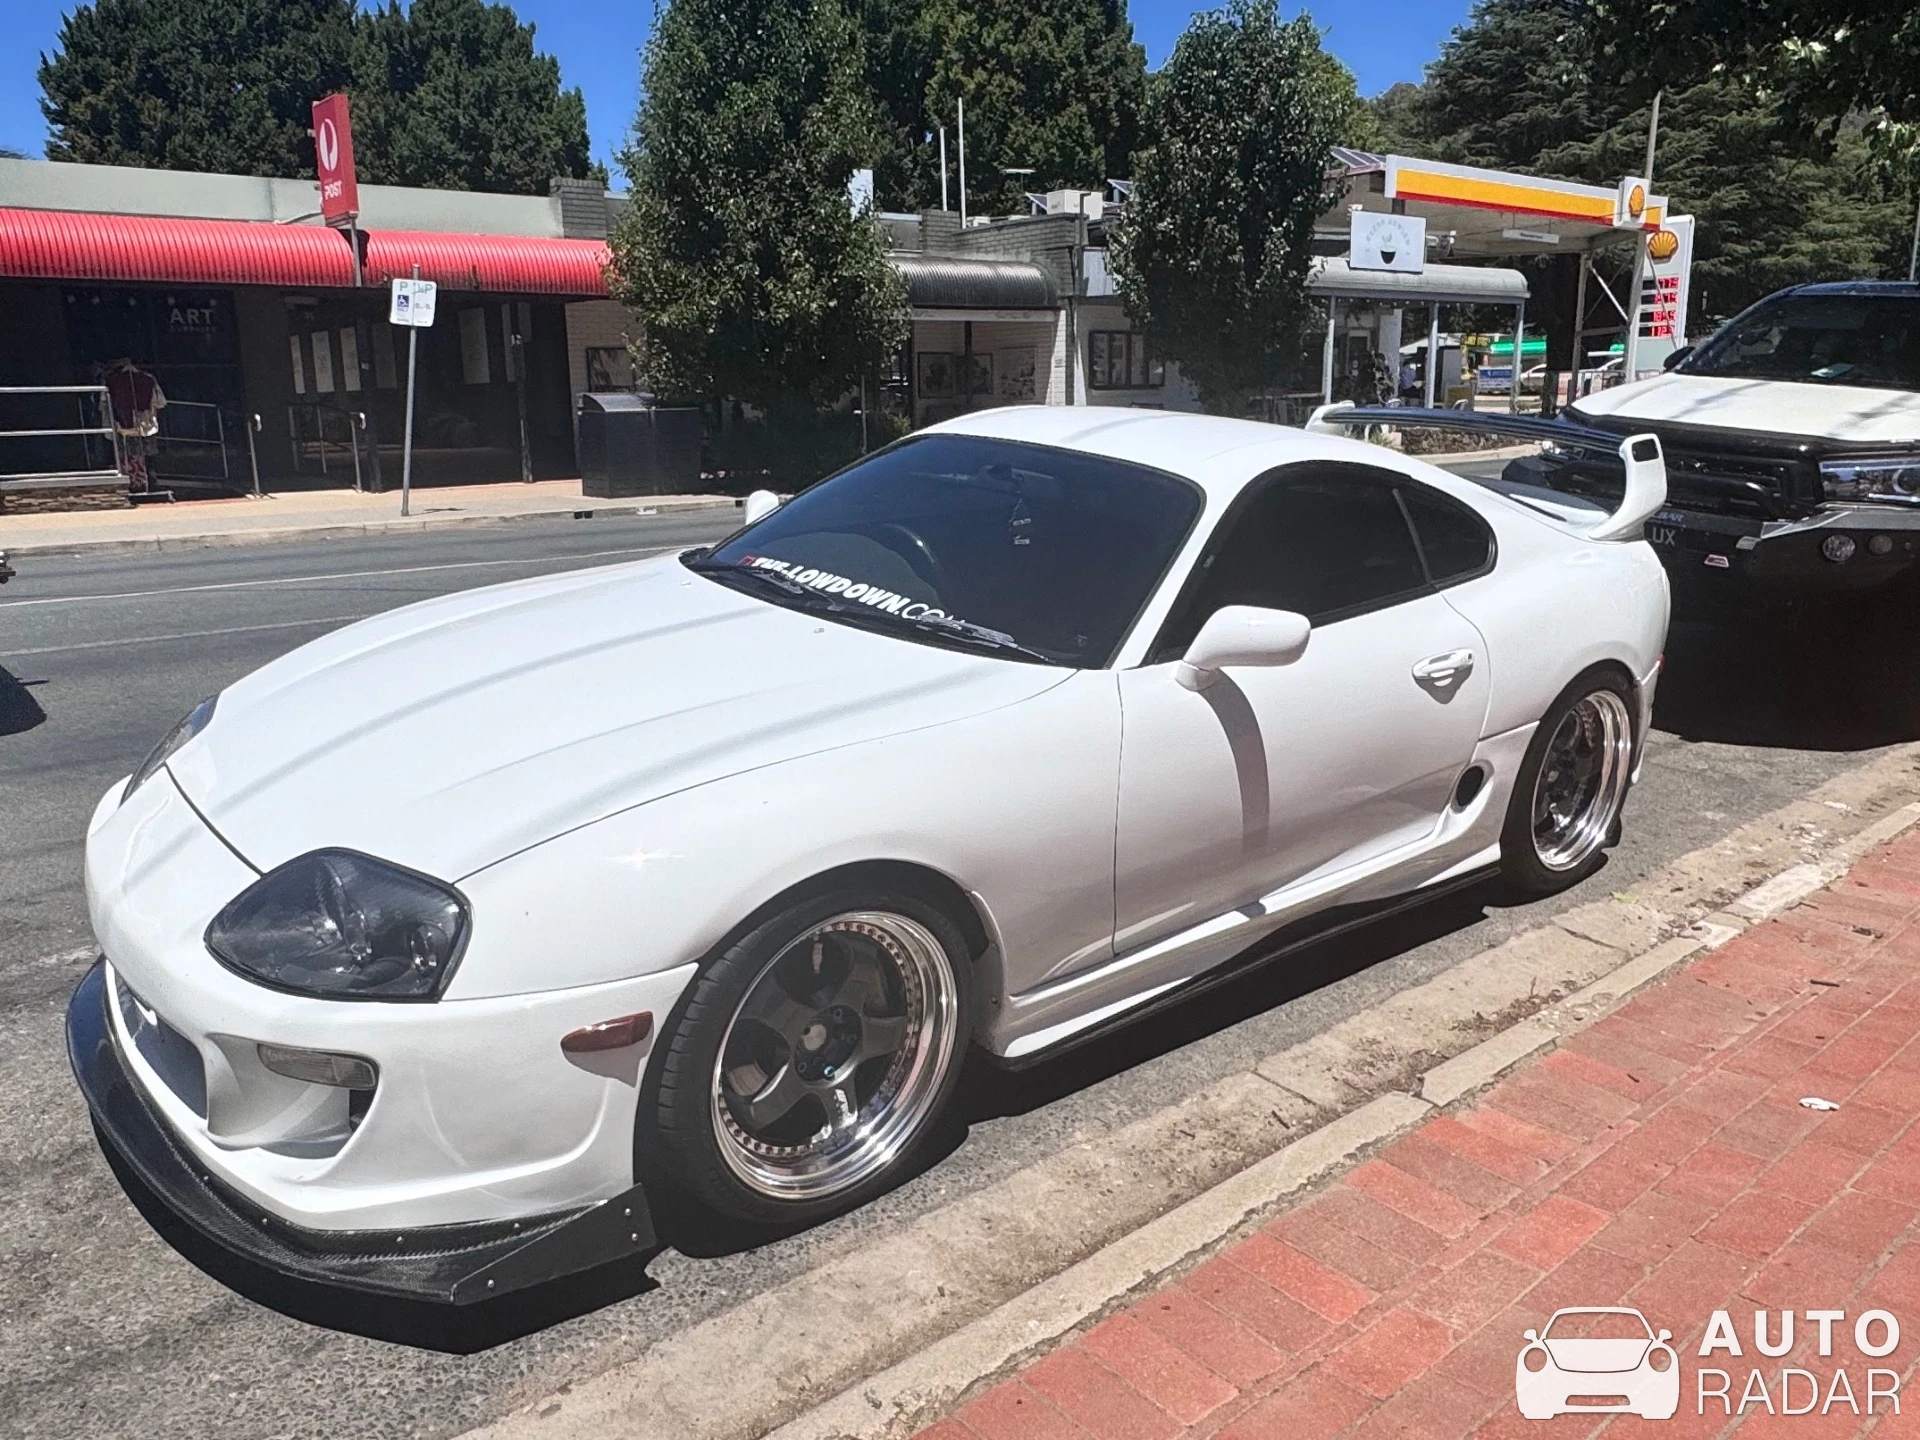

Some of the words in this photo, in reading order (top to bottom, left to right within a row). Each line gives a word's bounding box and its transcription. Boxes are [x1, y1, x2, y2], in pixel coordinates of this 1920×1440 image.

[324, 180, 342, 200] POST
[170, 308, 213, 325] ART
[1648, 526, 1676, 547] UX
